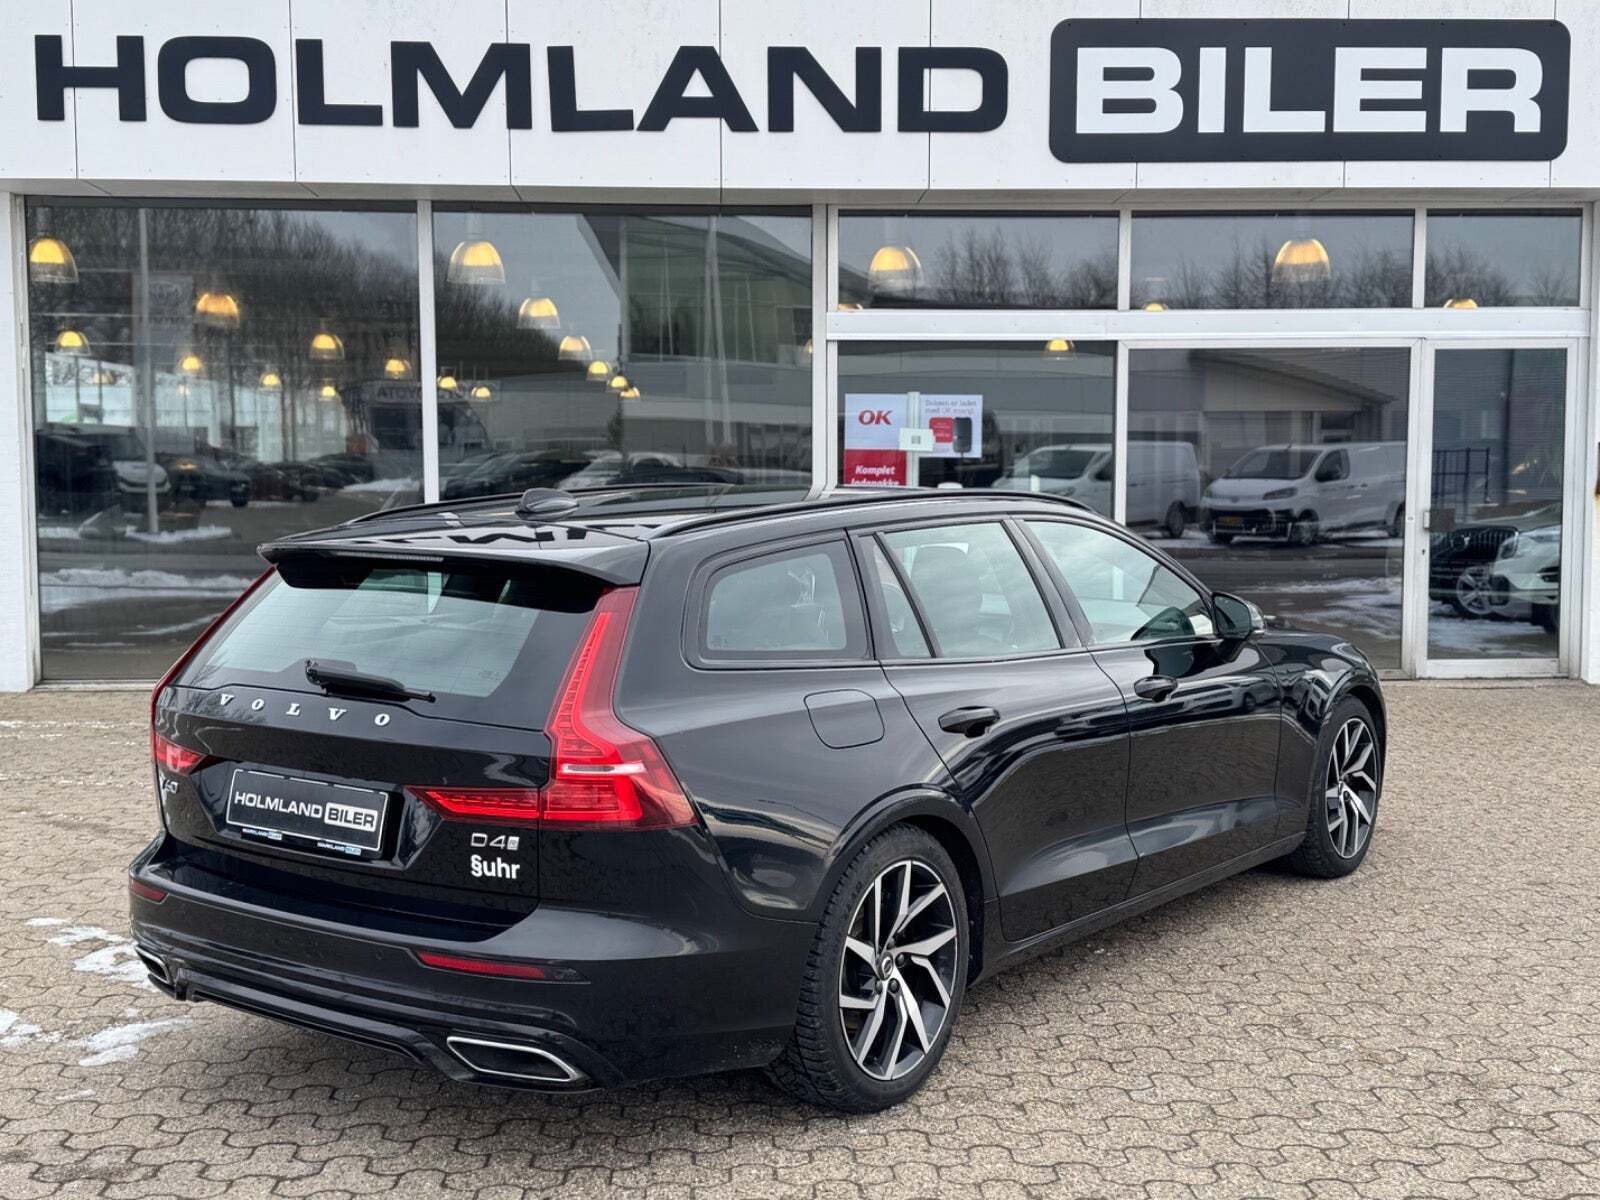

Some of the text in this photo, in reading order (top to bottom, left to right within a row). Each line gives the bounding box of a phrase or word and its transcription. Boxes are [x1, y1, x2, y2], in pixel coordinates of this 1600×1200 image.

[35, 35, 1543, 134] HOLMLAND BILER
[858, 410, 892, 425] OK
[855, 465, 896, 477] Komplet
[220, 693, 390, 727] VOLVO
[234, 791, 376, 829] HOLMLAND BILER
[470, 832, 506, 849] D4
